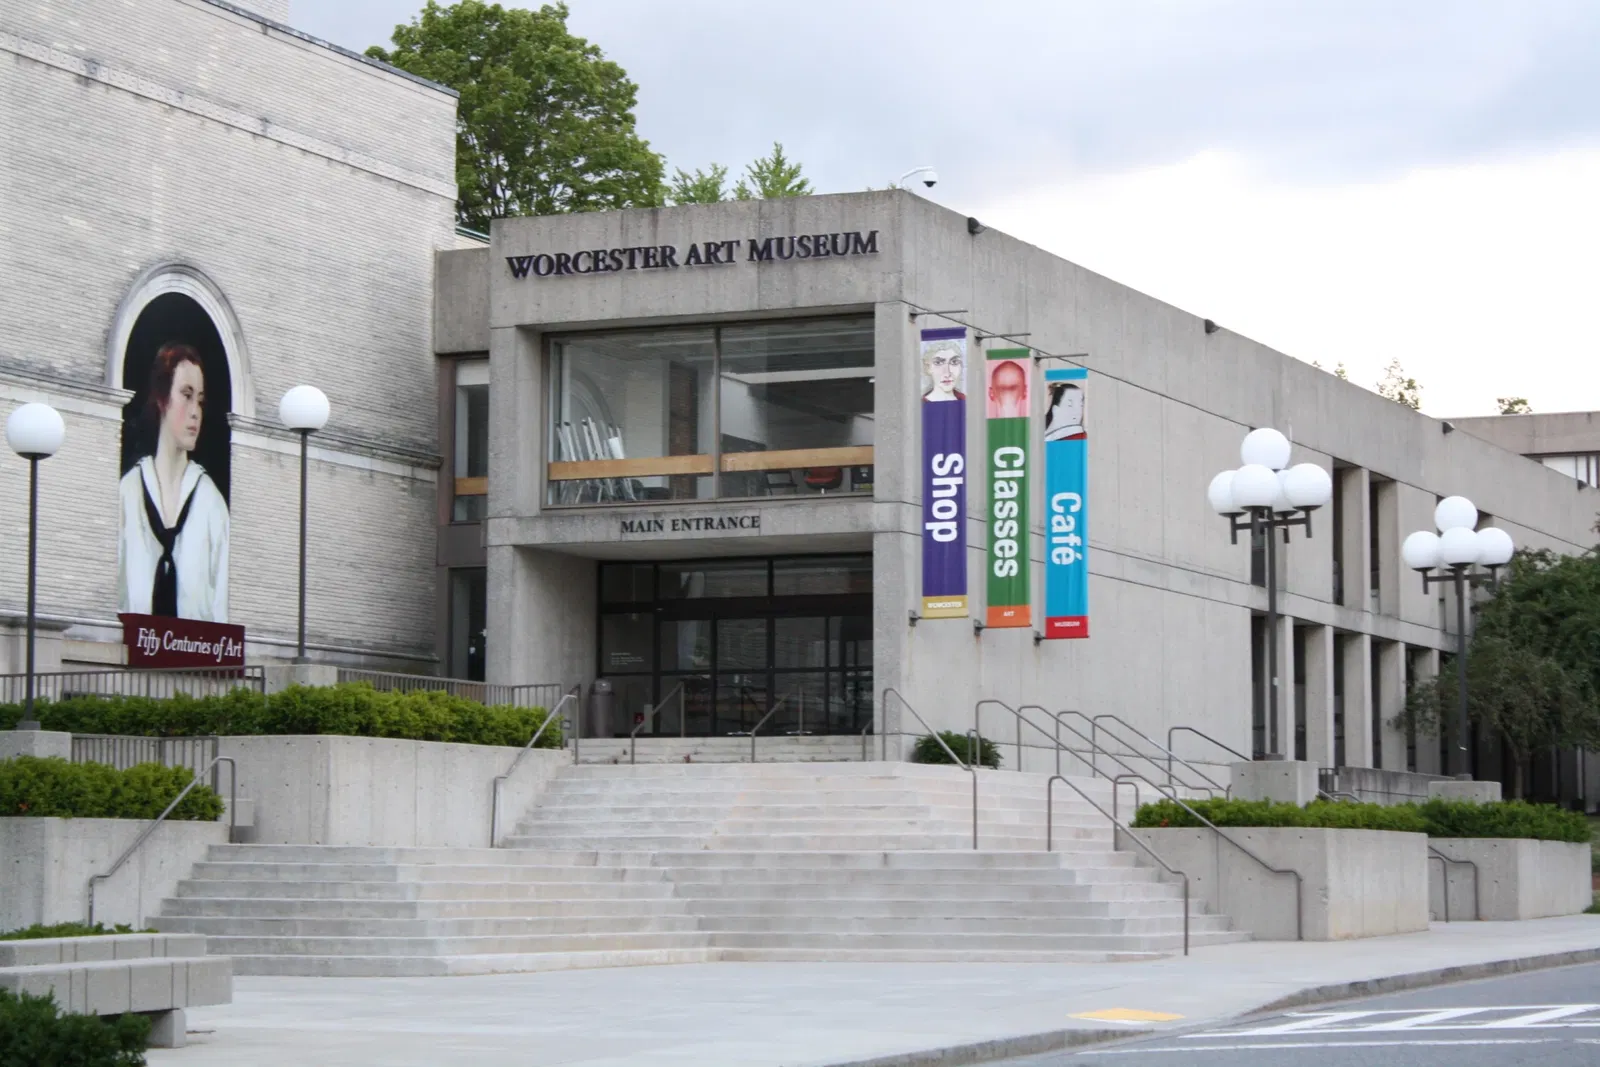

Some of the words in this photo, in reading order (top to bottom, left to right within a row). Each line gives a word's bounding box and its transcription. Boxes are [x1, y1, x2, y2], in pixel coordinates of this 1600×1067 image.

[506, 245, 678, 279] WORCESTER
[684, 240, 740, 266] ART
[749, 230, 879, 262] MUSEUM
[621, 519, 664, 533] MAIN
[671, 515, 760, 531] ENTRANCE
[925, 453, 964, 542] Shop
[994, 446, 1025, 578] Classes
[1051, 492, 1082, 565] Café
[137, 627, 161, 656] Fifty
[163, 630, 211, 654] Centuries
[212, 636, 226, 662] of
[224, 637, 242, 657] Art
